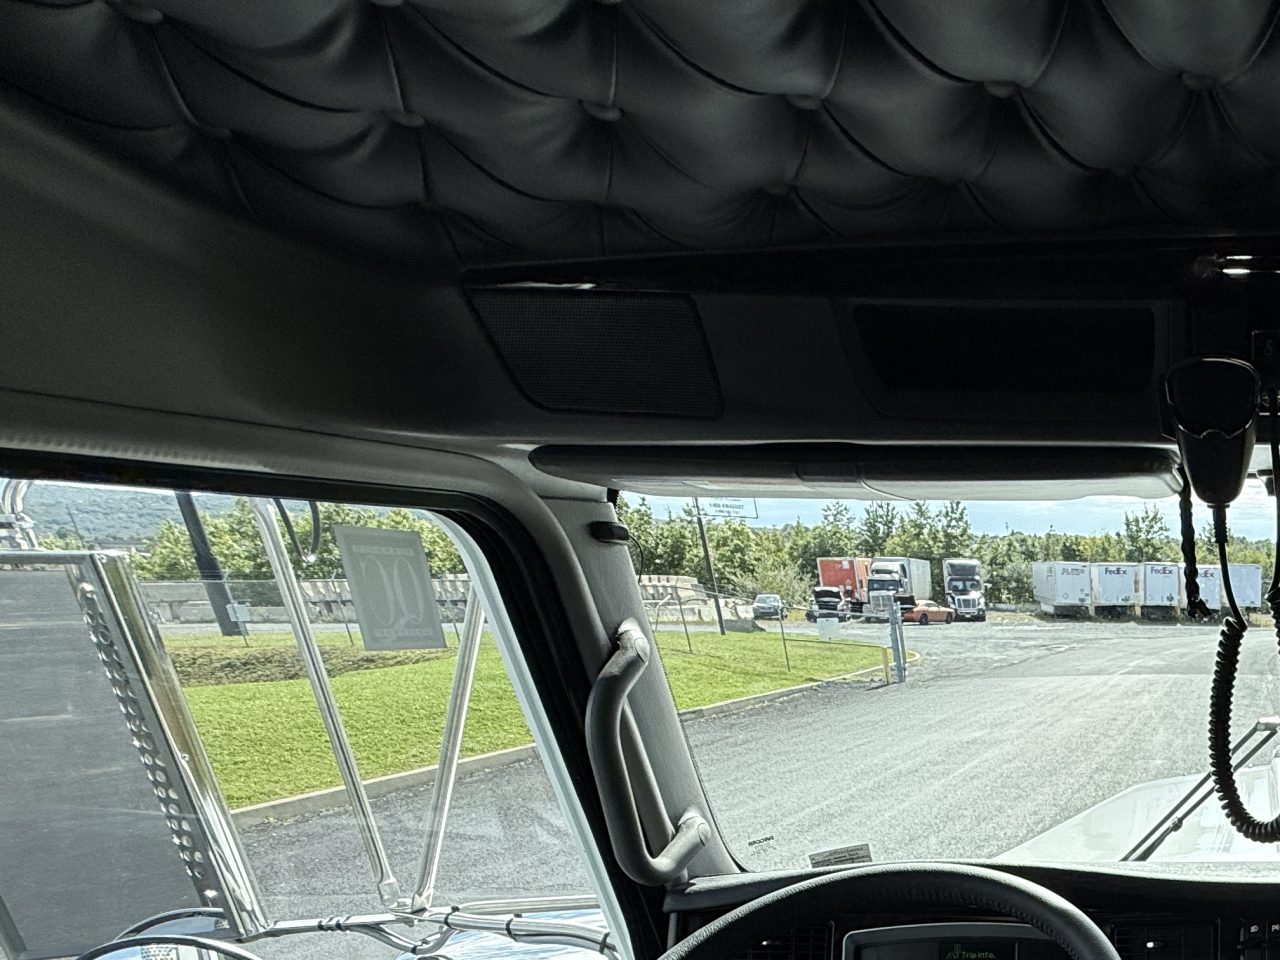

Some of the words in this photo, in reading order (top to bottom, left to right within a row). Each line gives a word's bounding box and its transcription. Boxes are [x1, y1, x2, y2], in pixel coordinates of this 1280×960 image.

[1105, 567, 1127, 575] FedEx
[1150, 566, 1173, 575] FedEx
[961, 951, 977, 960] Trip
